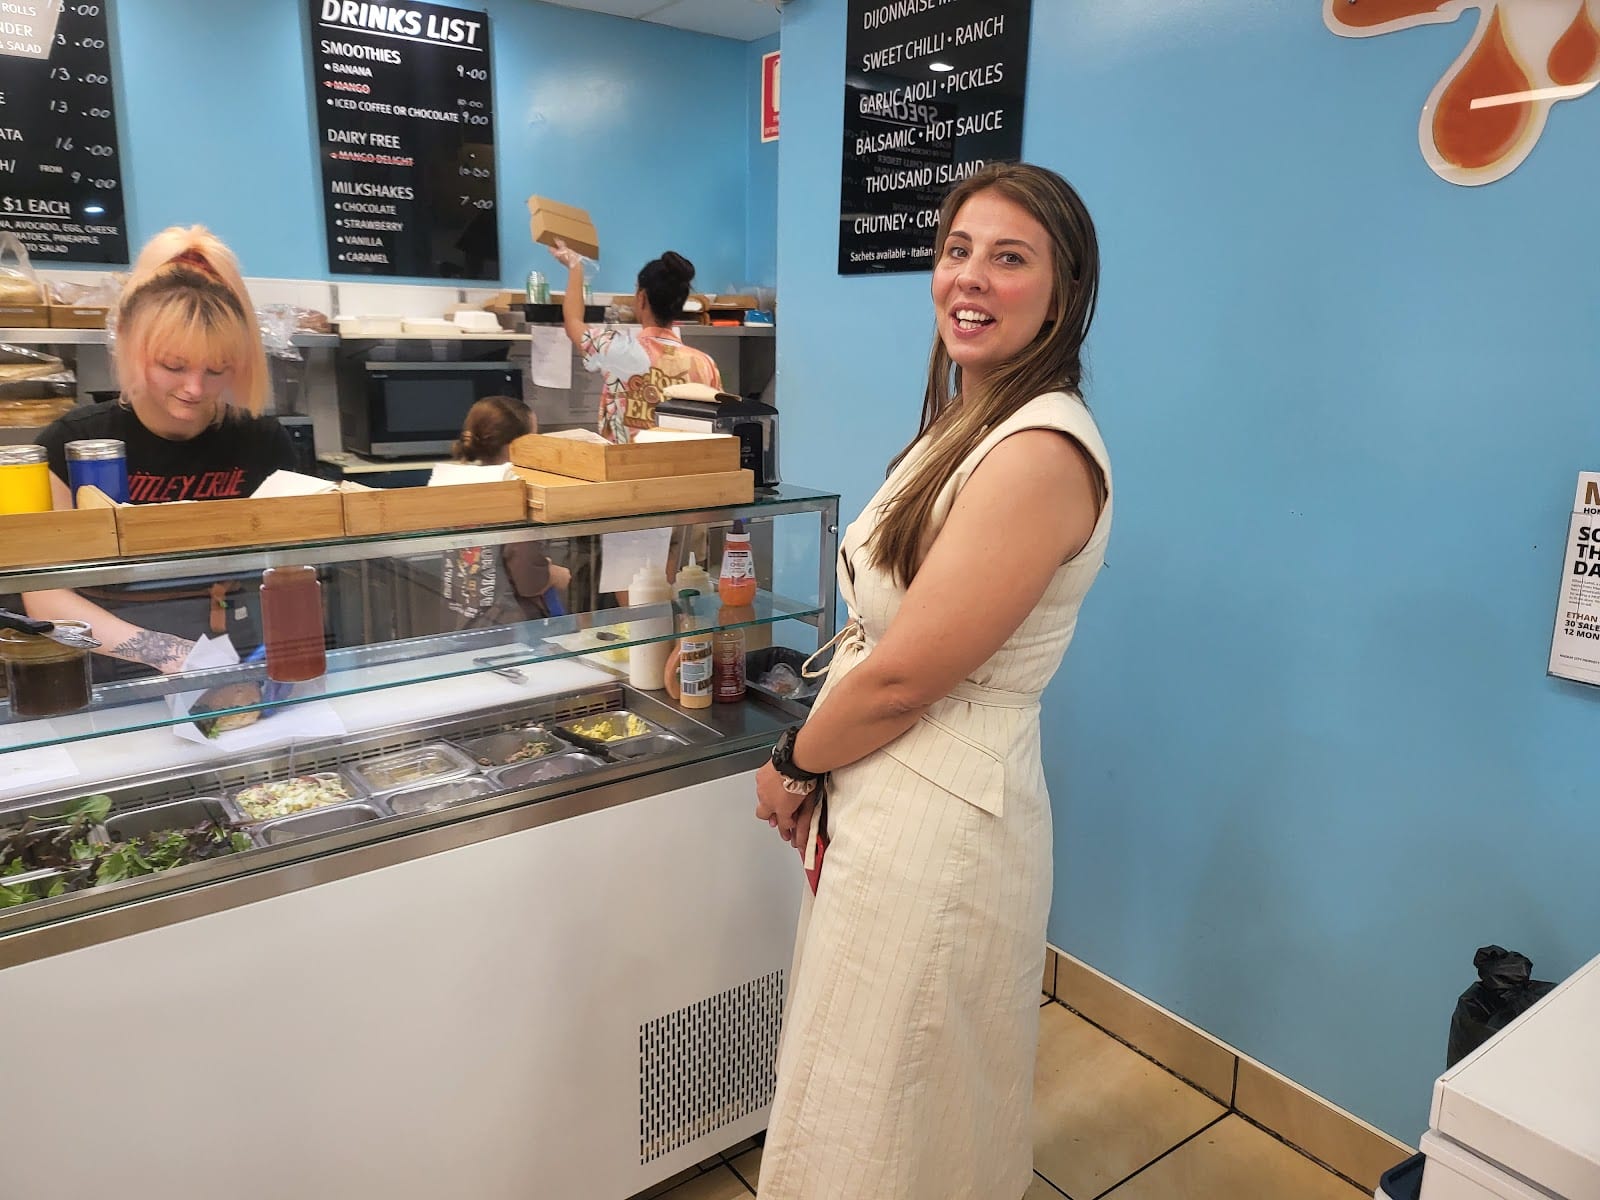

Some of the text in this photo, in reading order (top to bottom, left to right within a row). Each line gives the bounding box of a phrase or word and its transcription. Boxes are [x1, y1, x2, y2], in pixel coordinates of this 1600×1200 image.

[2, 2, 37, 17] ROLLS
[863, 0, 936, 30] DIJONNAISE
[320, 0, 481, 45] DRINKS LIST
[7, 41, 42, 54] SALAD
[862, 15, 1004, 72] SWEET CHILLI RANCH
[320, 39, 401, 65] SMOOTHIES
[332, 62, 374, 78] BANANA
[333, 80, 372, 95] MANGO
[859, 62, 1004, 114] GARLIC AIOLI PICKLES
[334, 98, 460, 123] ICED COFFEE OR CHOCOLATE
[327, 128, 401, 149] DAIRY FREE
[856, 128, 916, 156] BALSAMIC
[926, 119, 953, 143] HOT
[956, 109, 1003, 137] SAUCE
[339, 150, 415, 167] MANGO DELIGHT
[866, 159, 985, 194] THOUSAND ISLAND
[331, 180, 415, 200] MILKSHAKES
[3, 196, 71, 214] $1 EACH
[342, 201, 397, 216] CHOCOLATE
[84, 225, 119, 236] CHEESE
[343, 218, 404, 232] STRAWBERRY
[854, 212, 907, 235] CHUTNEY
[52, 233, 100, 245] PINEAPPLE
[344, 235, 384, 247] VANILLA
[39, 243, 69, 254] SALAD
[850, 246, 934, 262] Sachets available Italian
[346, 252, 390, 264] CARAMEL
[1565, 620, 1576, 628] 30
[1566, 611, 1598, 623] ETHAN
[1564, 628, 1574, 636] 12
